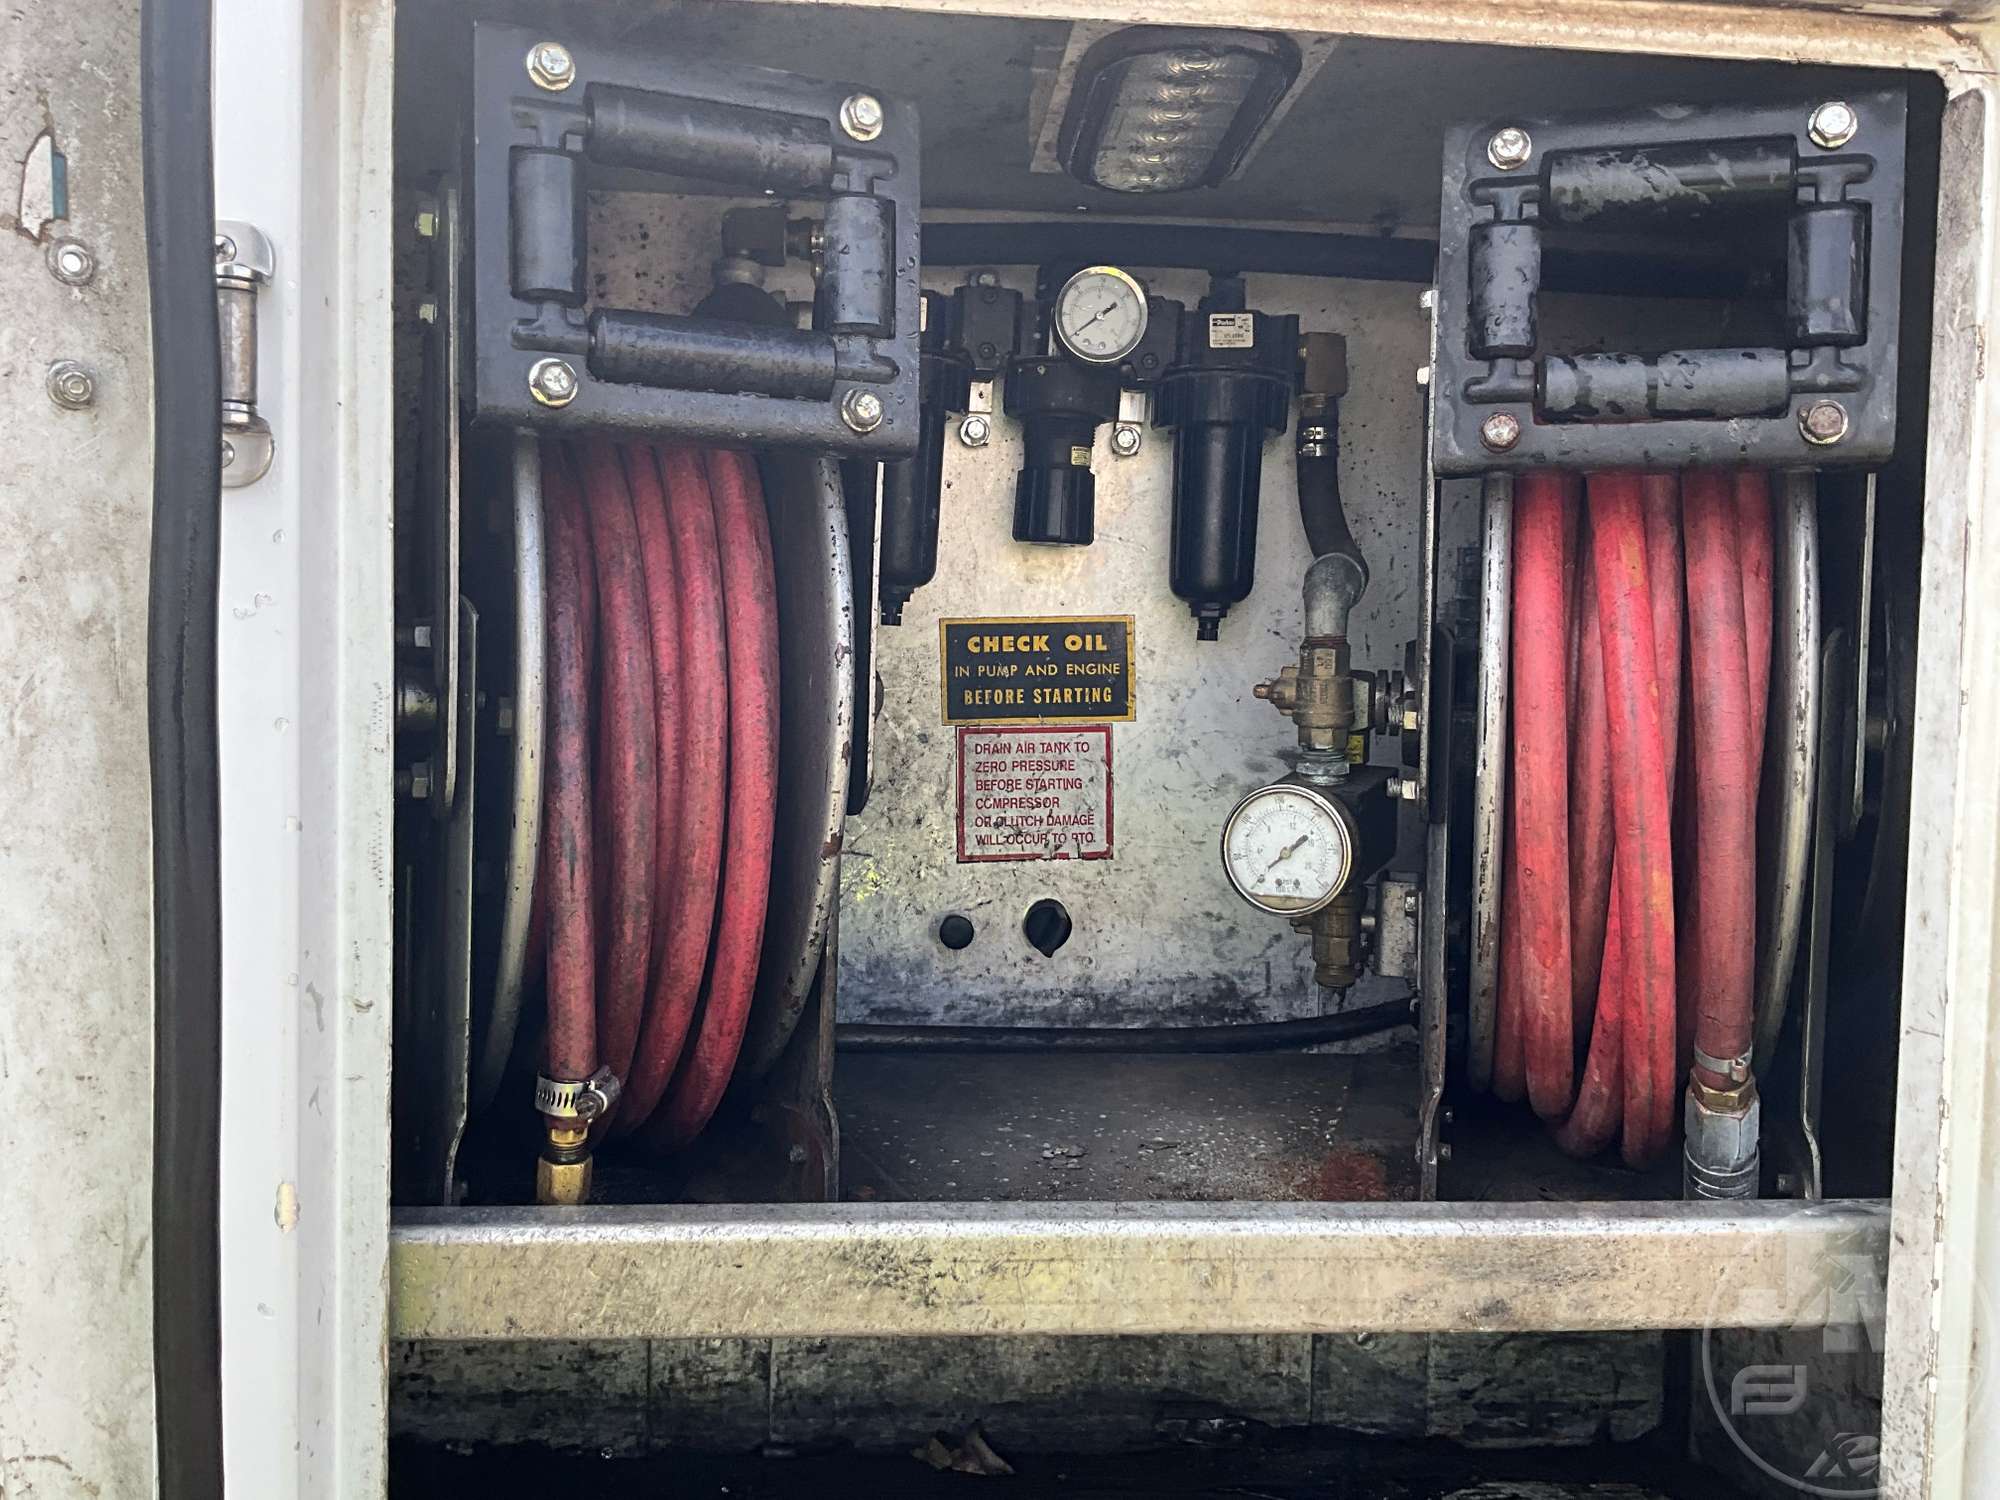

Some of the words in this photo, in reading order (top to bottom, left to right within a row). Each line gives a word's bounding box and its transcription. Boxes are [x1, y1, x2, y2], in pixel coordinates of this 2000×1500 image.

[967, 634, 1050, 653] CHECK
[1064, 633, 1108, 652] OIL
[954, 666, 970, 678] IN
[978, 665, 1018, 678] PUMP
[1025, 664, 1058, 677] AND
[1066, 663, 1121, 676] ENGINE
[964, 688, 1025, 706] BEFORE
[1033, 687, 1112, 704] STARTING
[974, 742, 1012, 755] DRAIN
[1015, 742, 1035, 754] AIR
[1040, 741, 1072, 754] TANK
[1074, 741, 1090, 753] TO
[975, 761, 1007, 773] ZERO
[1012, 760, 1076, 772] PRESSURE
[975, 779, 1022, 791] BEFORE
[1025, 778, 1083, 790] STARTING
[975, 797, 1060, 810] COMPRESSOR
[975, 816, 992, 828] OR
[995, 815, 1043, 827] CLUTCH
[1046, 814, 1095, 826] DAMAGE
[975, 835, 1004, 846] WILL
[1006, 833, 1049, 846] OCCUR
[1052, 832, 1067, 844] TO
